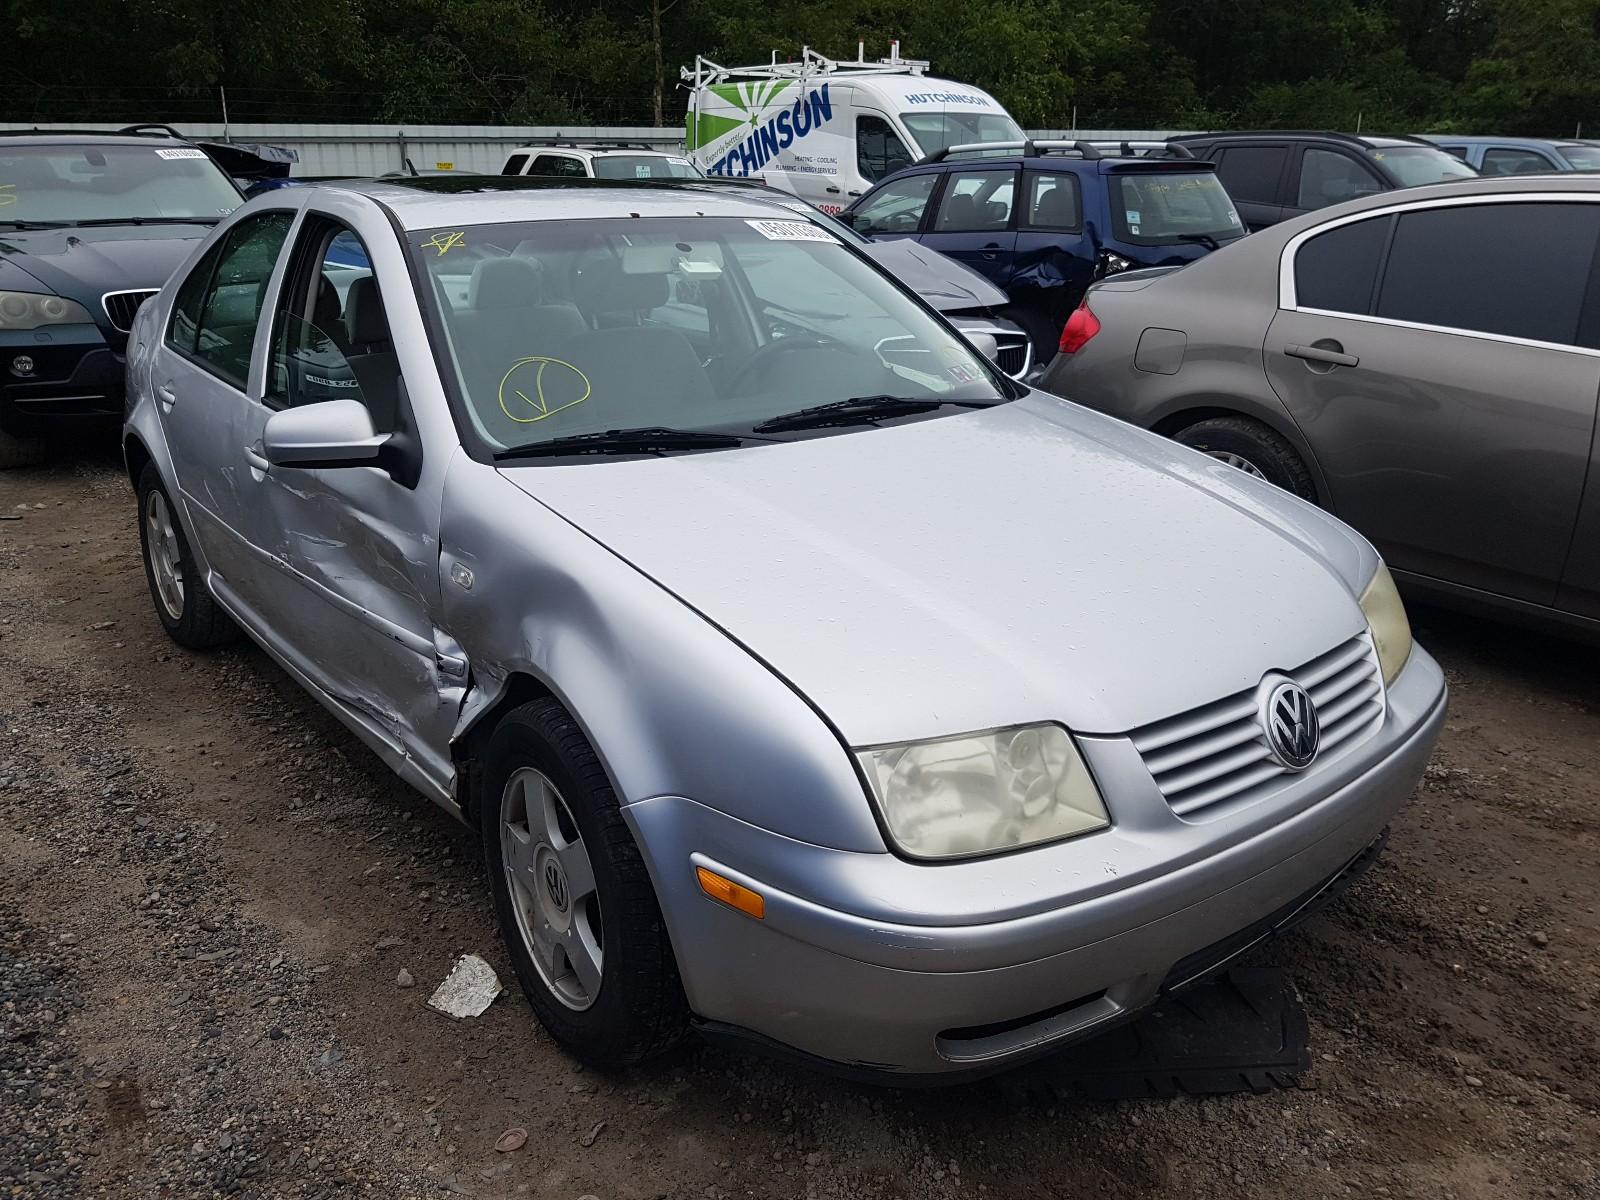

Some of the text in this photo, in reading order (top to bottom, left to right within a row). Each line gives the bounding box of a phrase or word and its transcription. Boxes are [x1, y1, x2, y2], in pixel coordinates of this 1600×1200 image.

[904, 93, 991, 107] HUTCHINSON
[706, 82, 833, 177] TCHINSON
[794, 155, 813, 163] HEATING
